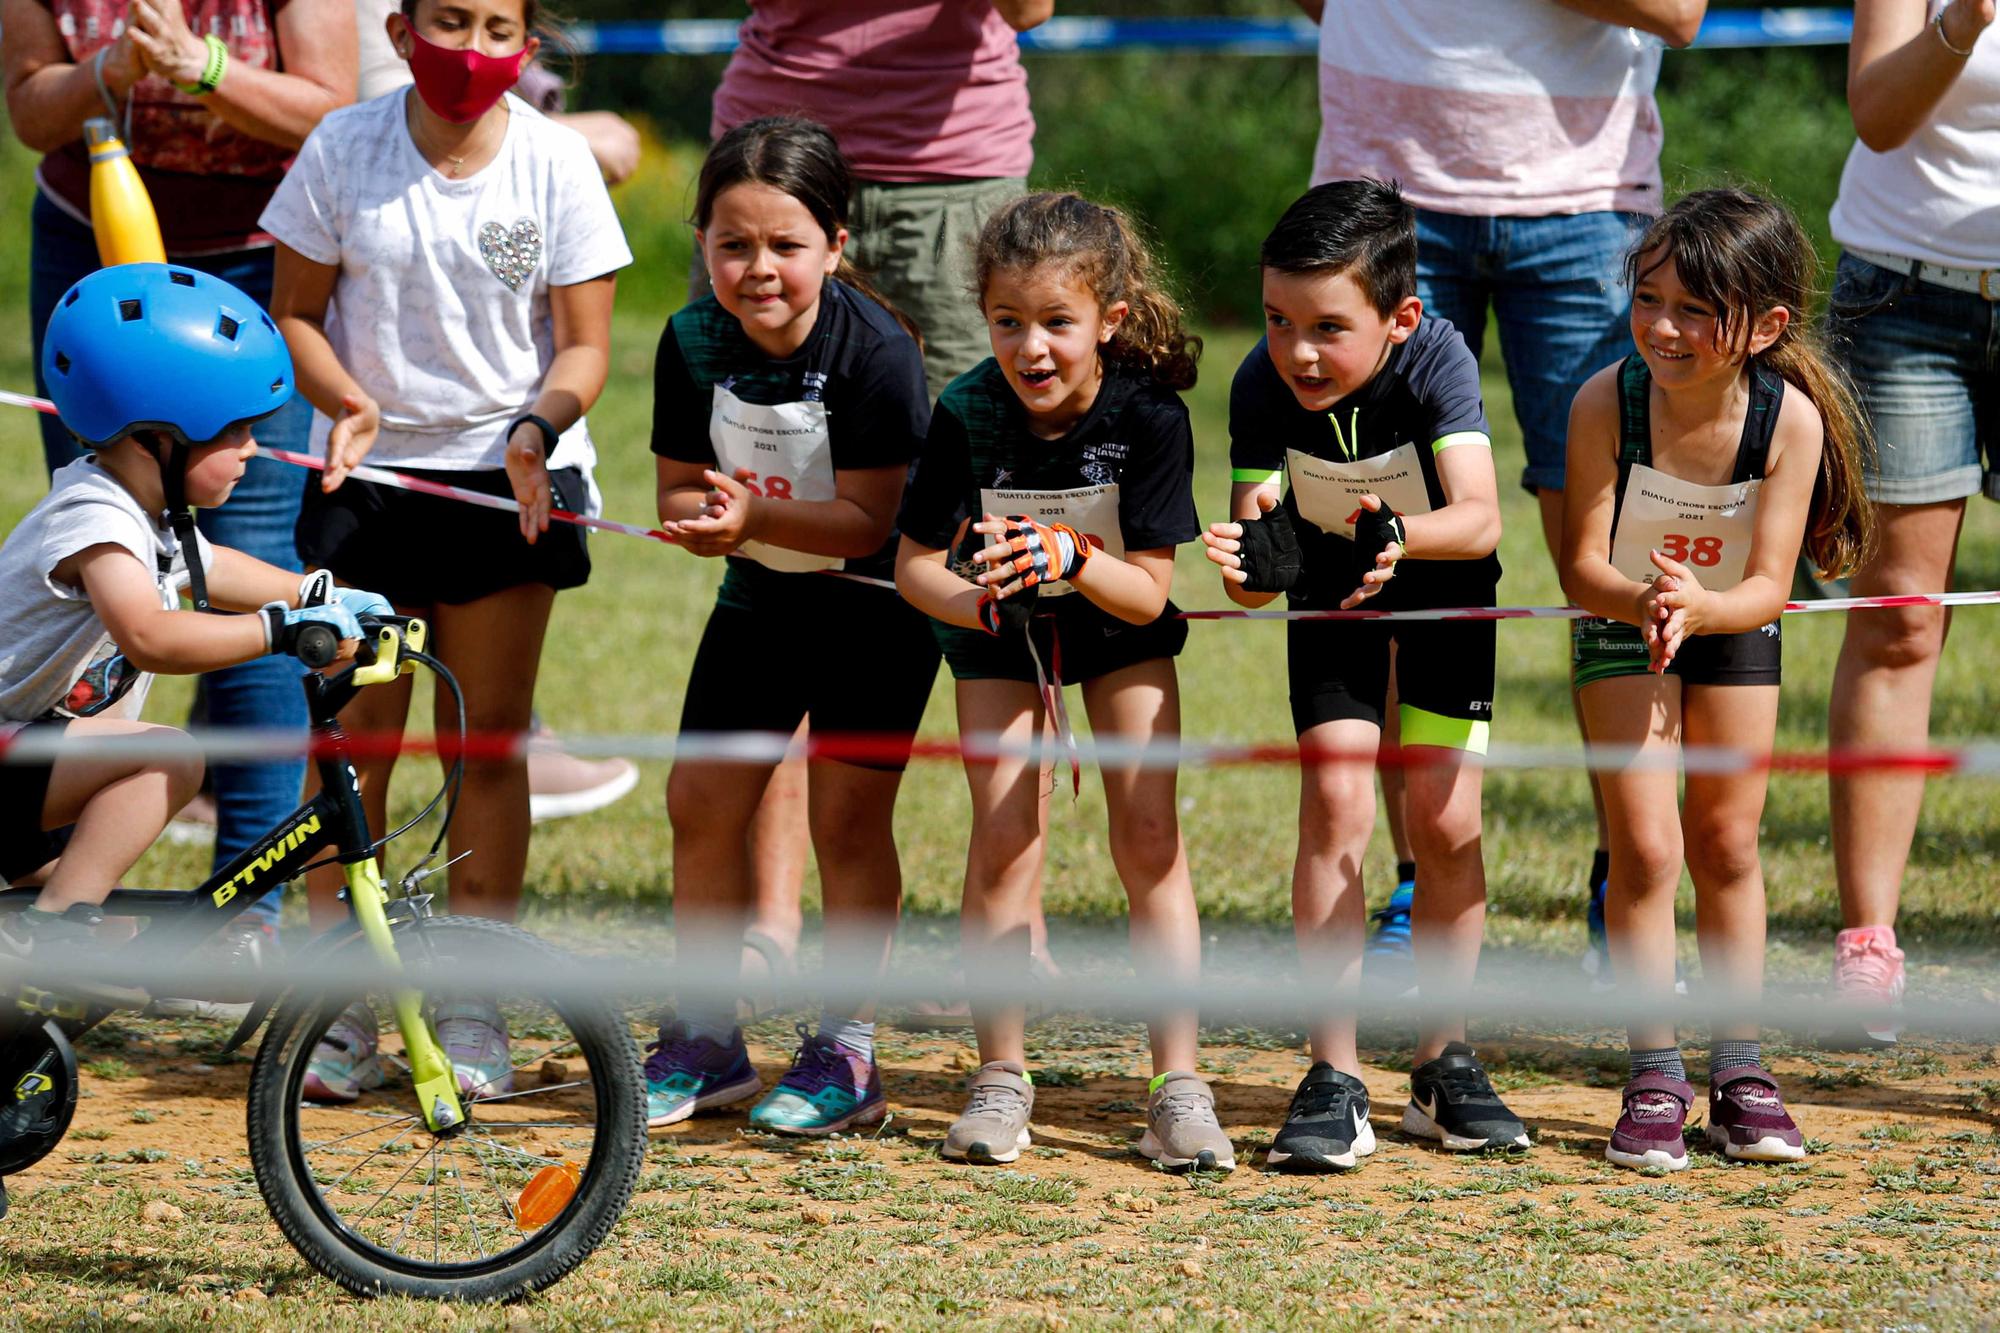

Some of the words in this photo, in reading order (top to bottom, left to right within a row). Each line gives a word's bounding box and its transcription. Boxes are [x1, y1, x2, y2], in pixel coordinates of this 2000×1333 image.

[748, 425, 774, 435] CROSS
[776, 427, 816, 436] ESCOLAR
[754, 441, 778, 452] 2021
[1303, 470, 1336, 482] DUATLÓ
[1368, 471, 1409, 483] ESCOLAR
[997, 492, 1031, 500] DUATLÓ
[1065, 488, 1105, 499] ESCOLAR
[1641, 489, 1675, 505] DUATLÓ
[1676, 501, 1705, 509] CROSS
[1708, 500, 1746, 510] ESCOLAR
[1661, 534, 1723, 567] 38
